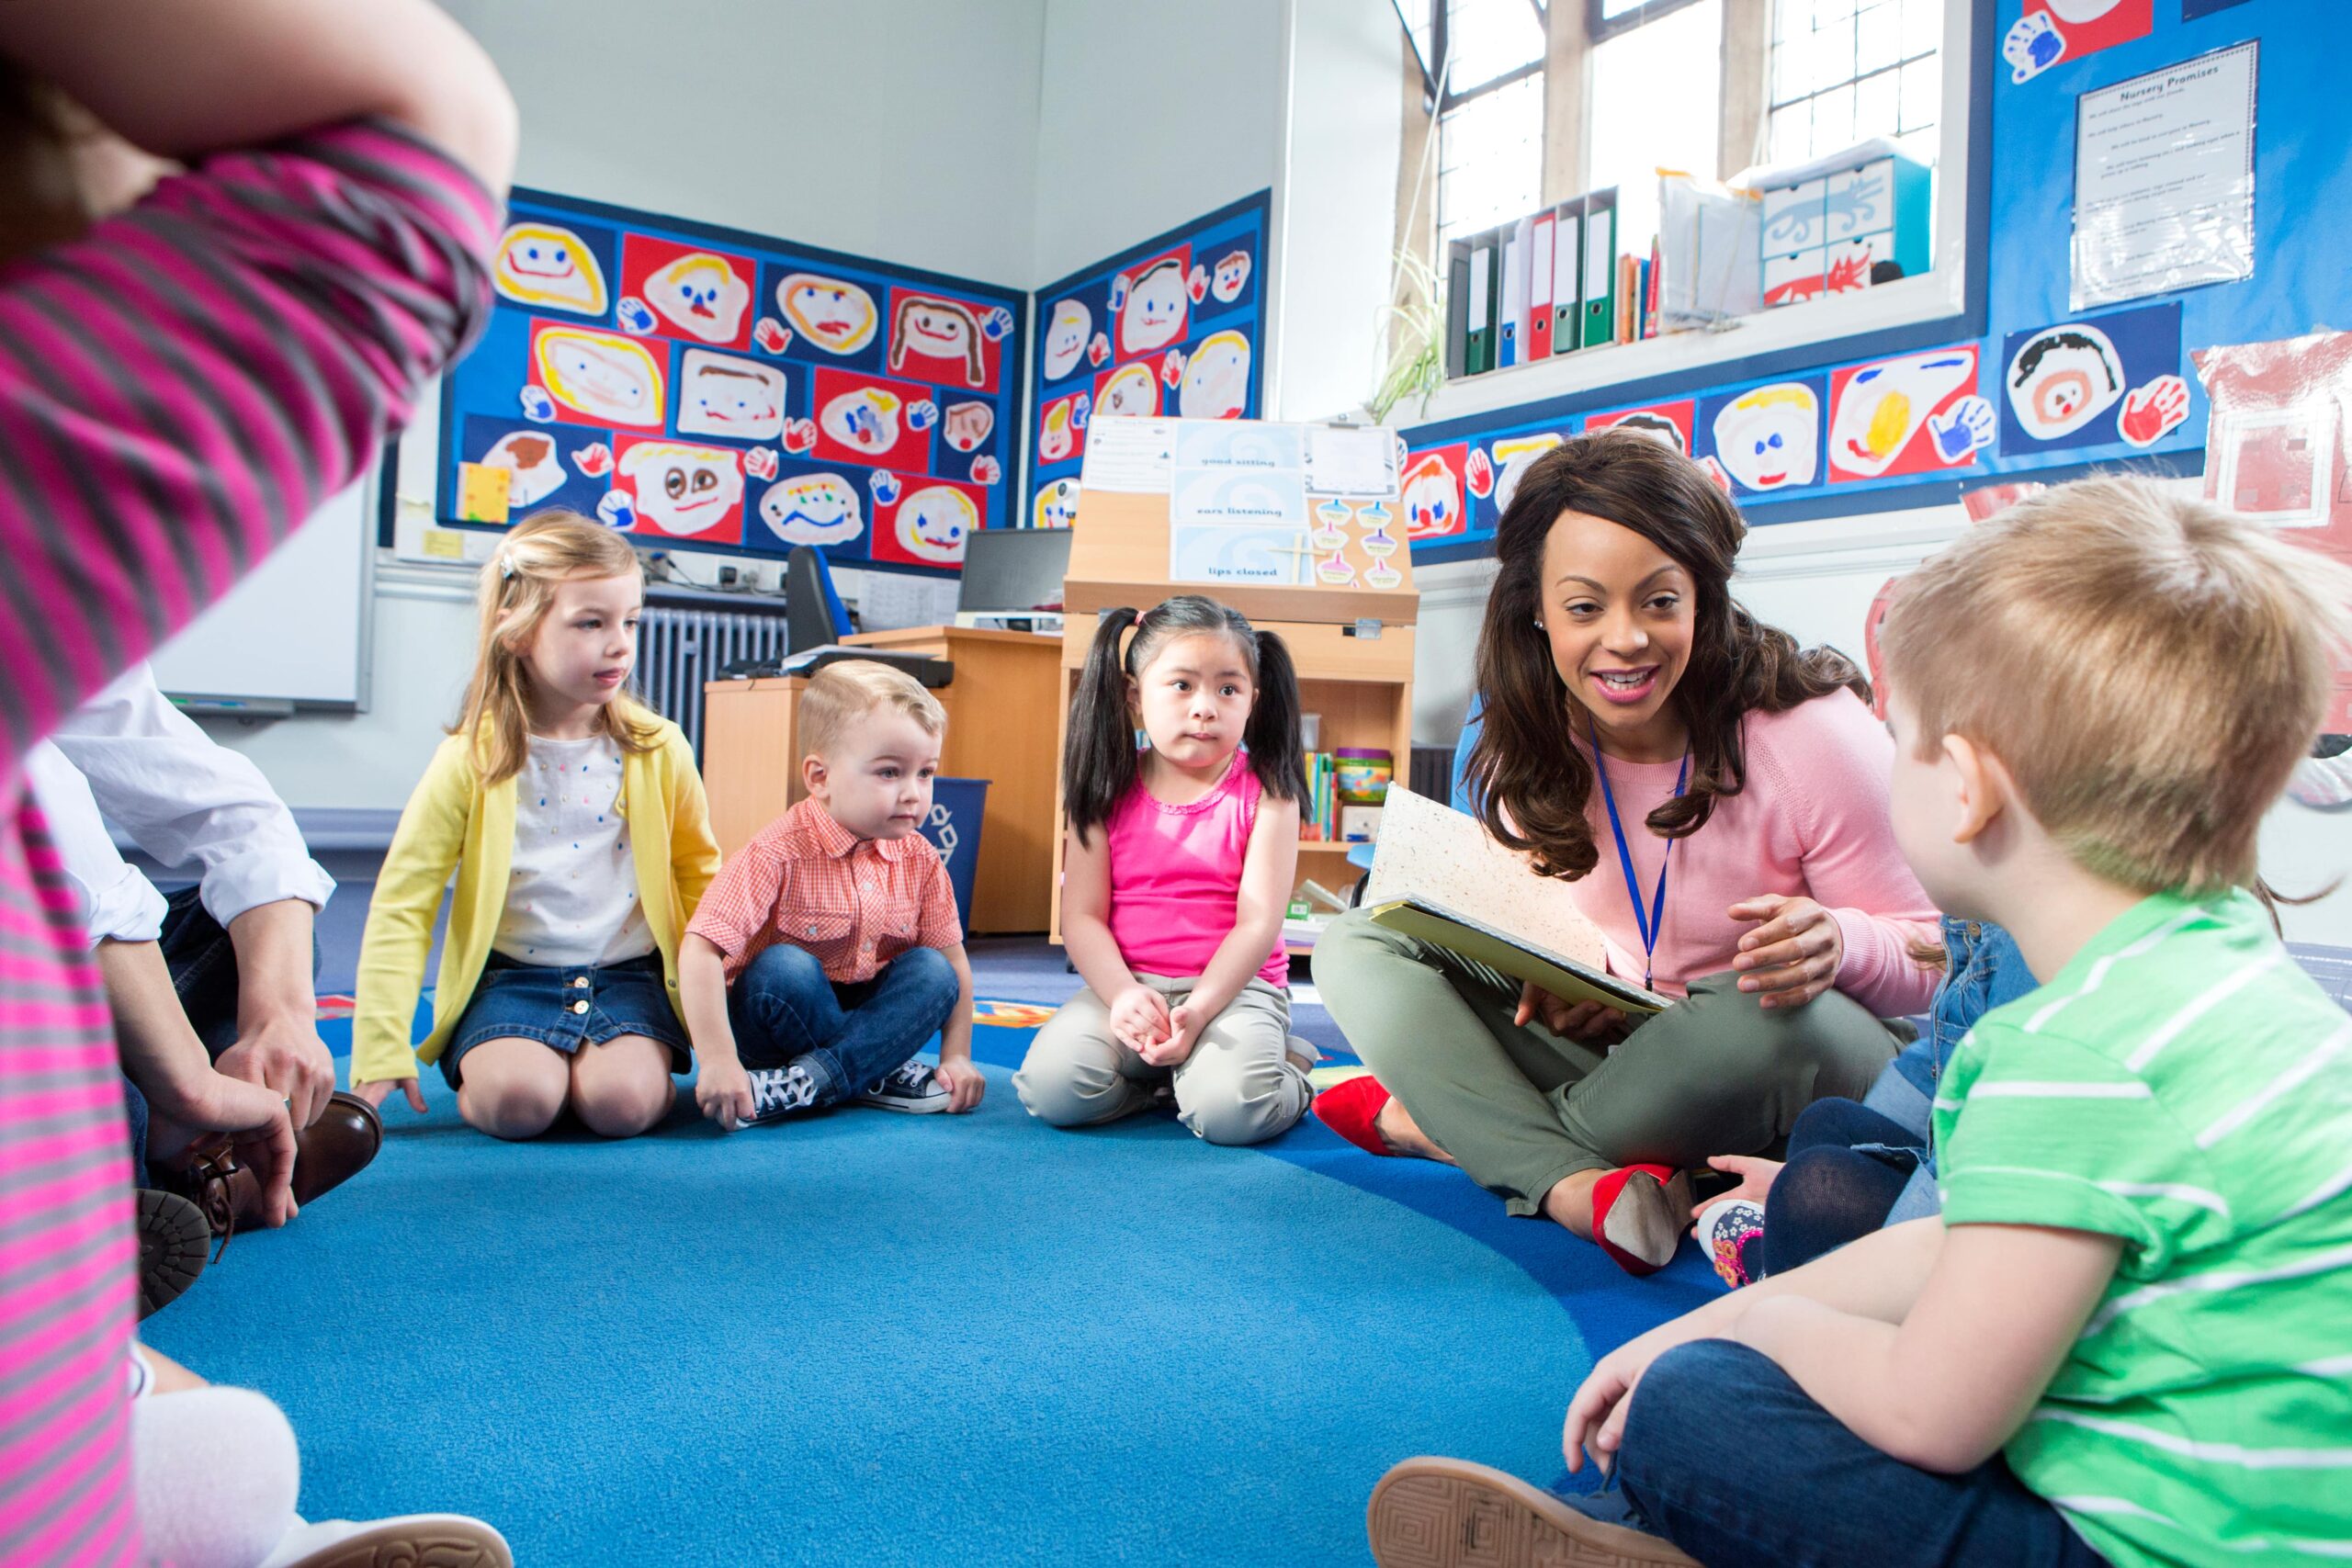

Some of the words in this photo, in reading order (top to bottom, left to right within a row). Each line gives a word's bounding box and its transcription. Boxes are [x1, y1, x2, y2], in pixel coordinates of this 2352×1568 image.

[2120, 83, 2164, 101] Nursery
[2167, 66, 2219, 87] Promises
[1227, 507, 1282, 517] listening
[1209, 567, 1231, 577] lips
[1237, 568, 1277, 576] closed
